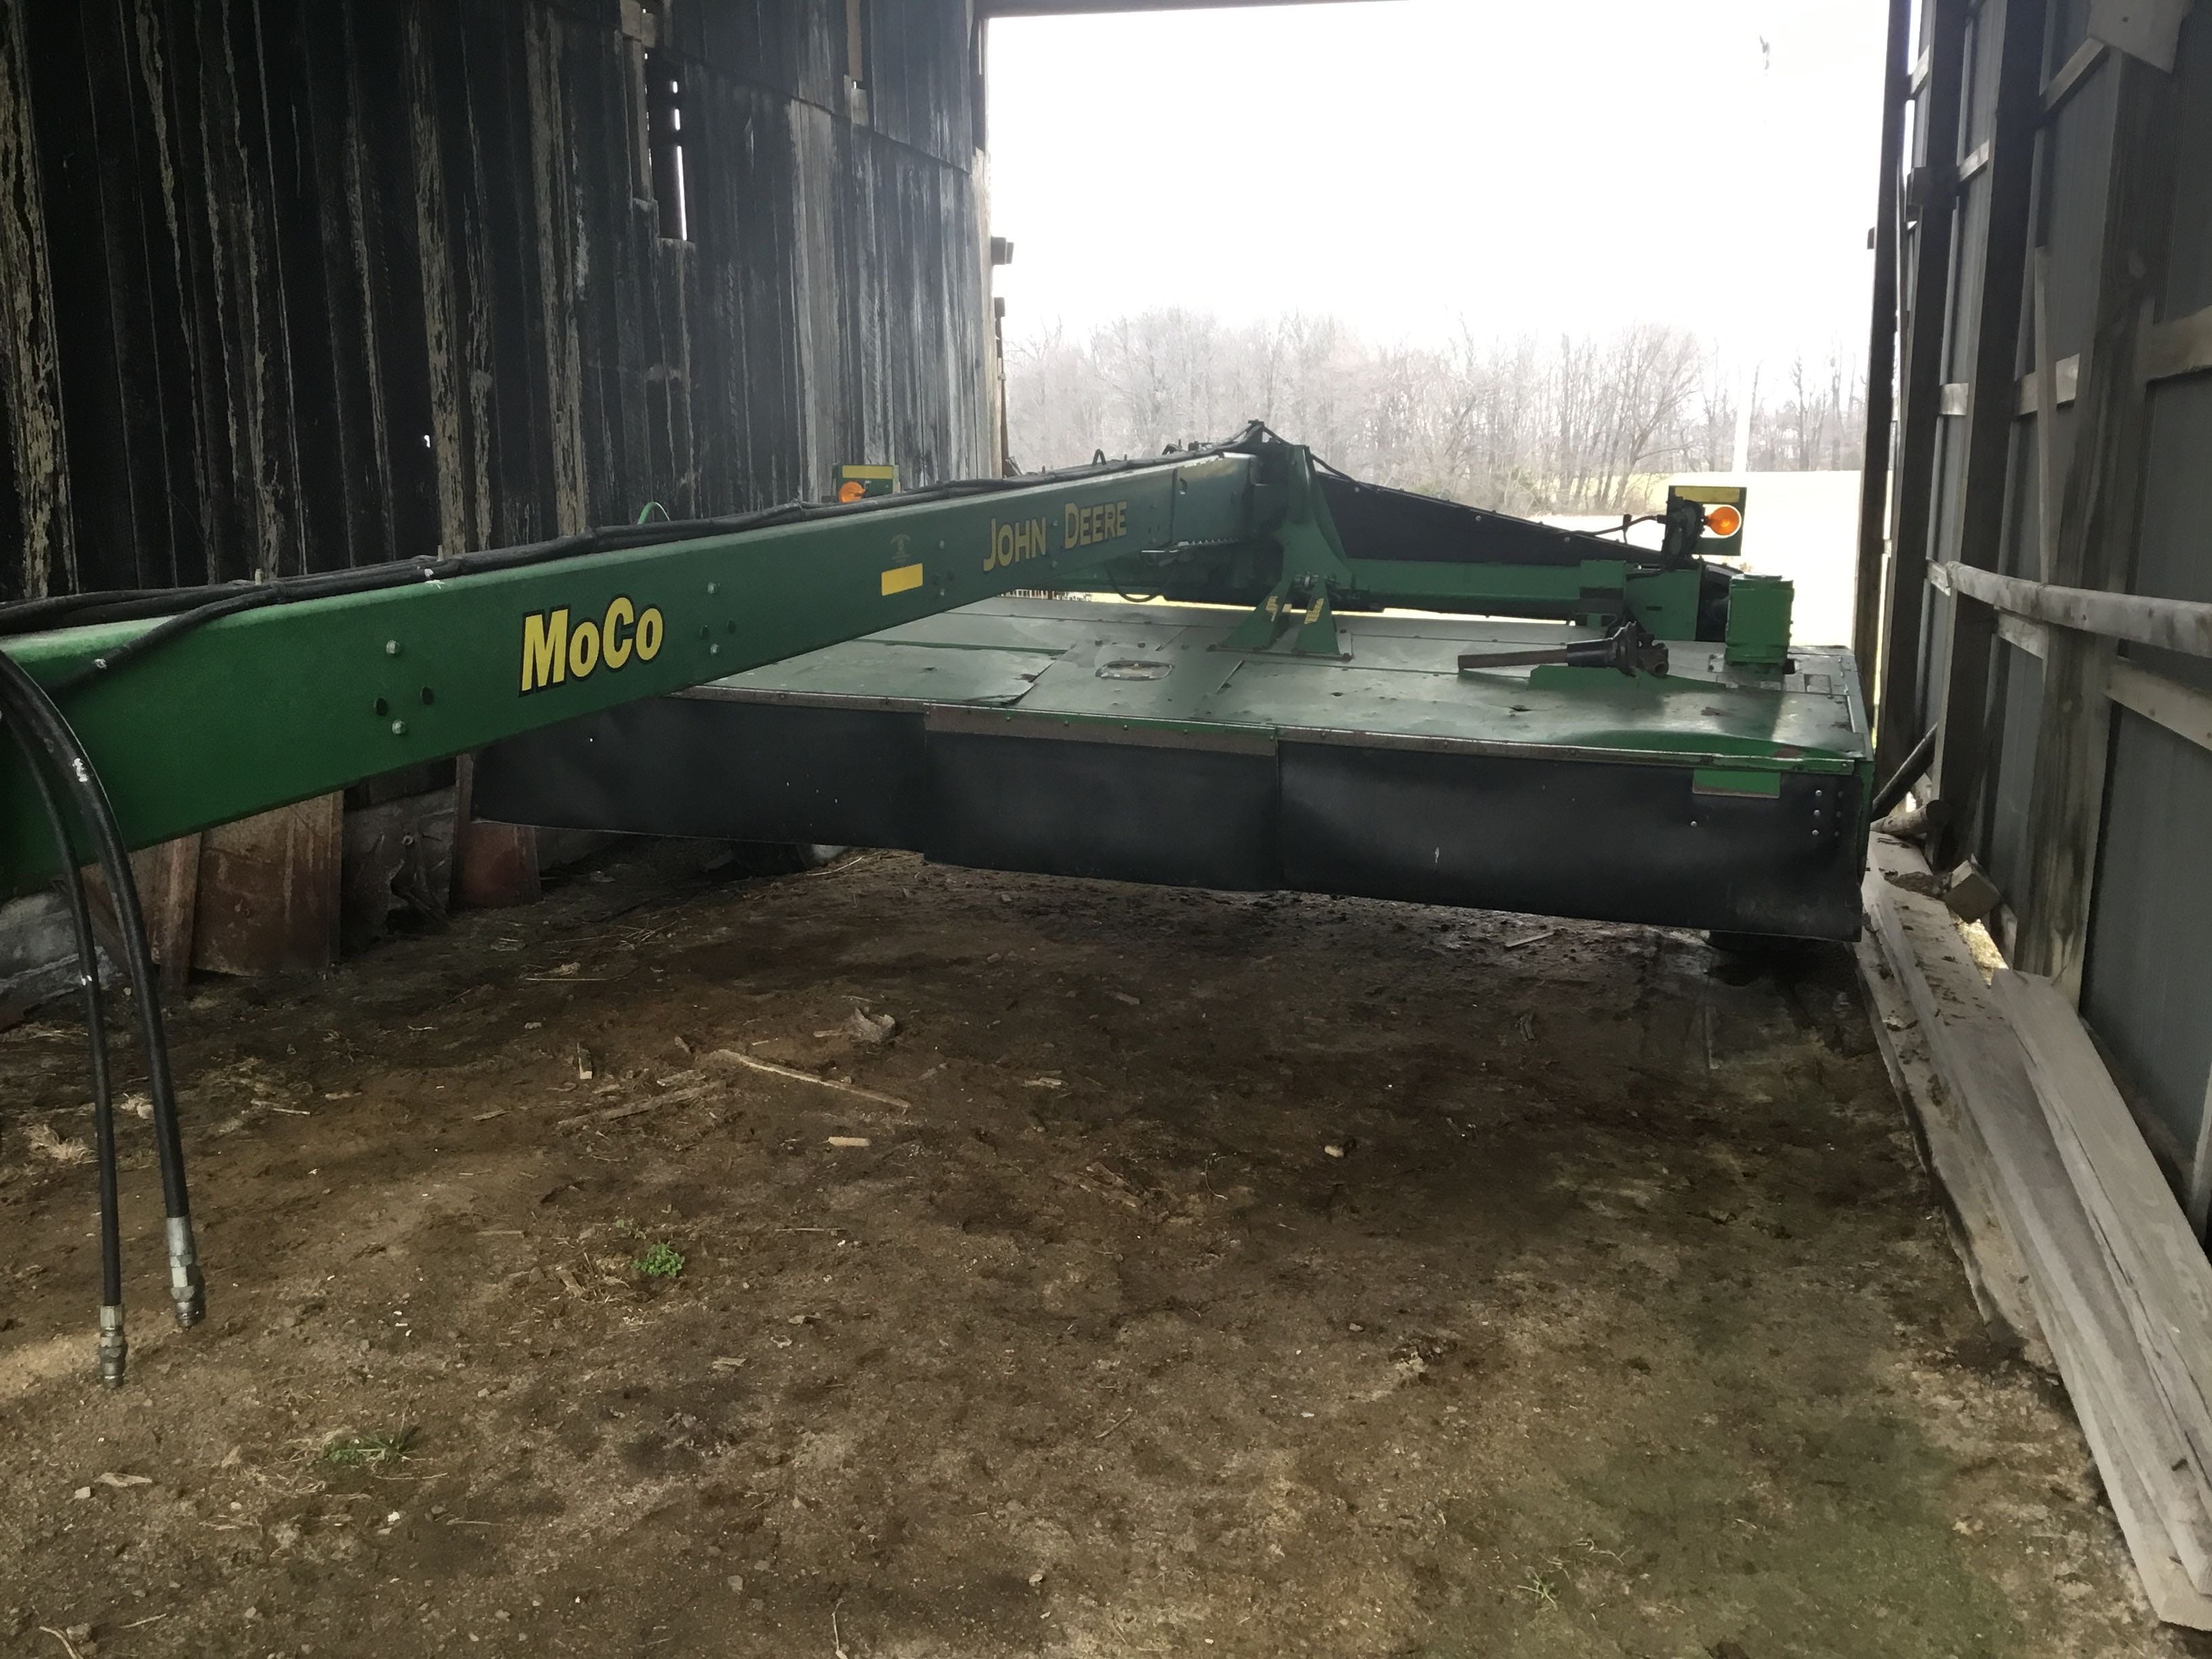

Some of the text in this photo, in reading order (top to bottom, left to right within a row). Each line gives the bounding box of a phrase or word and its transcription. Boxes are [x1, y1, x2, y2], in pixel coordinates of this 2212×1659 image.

[983, 501, 1128, 572] JOHN DEERE
[520, 595, 664, 694] MoCo
